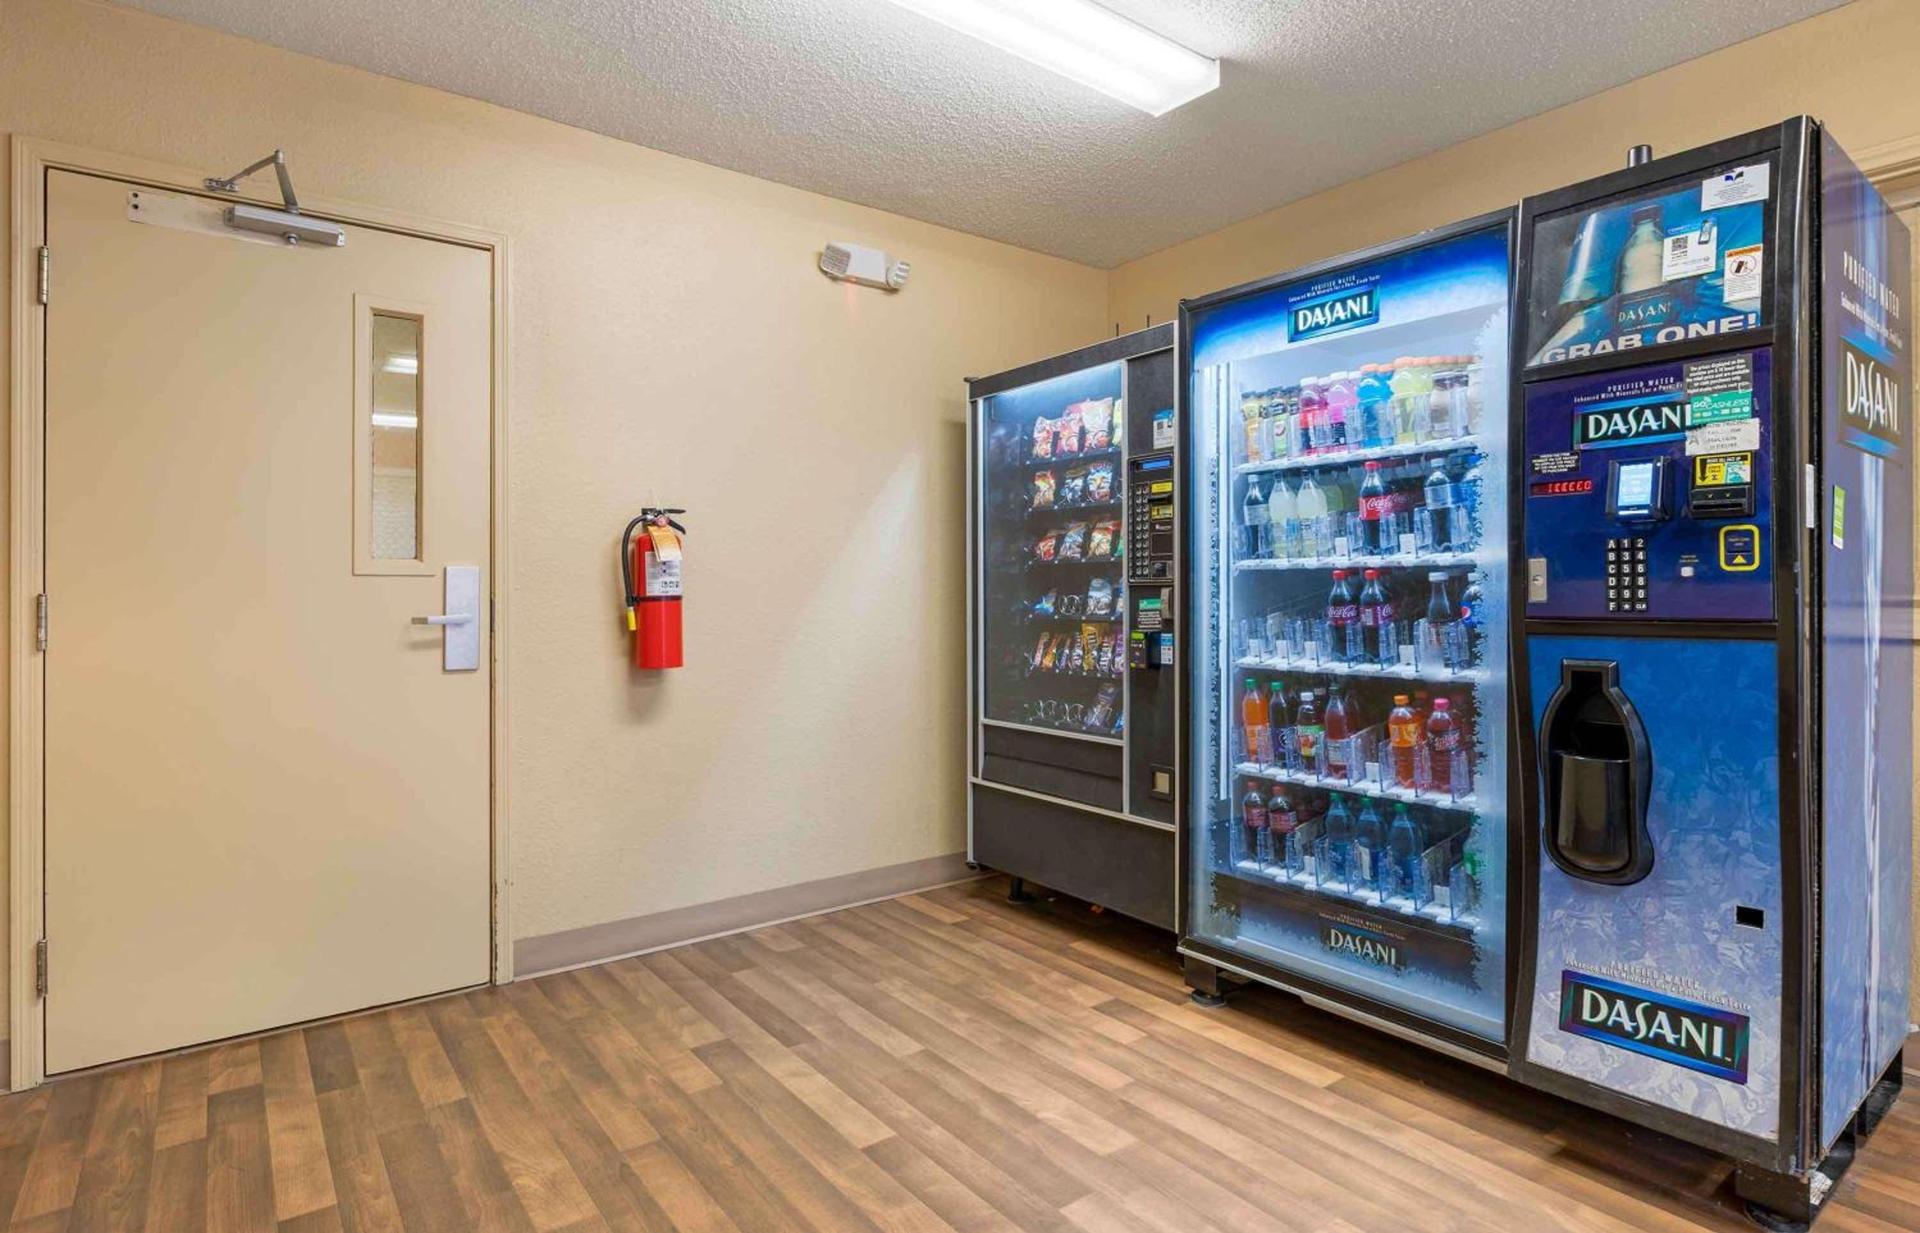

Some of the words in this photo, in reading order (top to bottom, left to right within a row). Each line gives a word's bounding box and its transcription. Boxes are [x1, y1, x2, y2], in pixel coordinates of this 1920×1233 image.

[1298, 296, 1368, 331] DASANI
[1618, 302, 1672, 322] DASANI
[1542, 333, 1642, 364] GRAB
[1656, 312, 1758, 344] ONE!
[1607, 380, 1644, 392] PURIFIED
[1648, 376, 1674, 386] WATER
[1846, 351, 1898, 434] DASANI
[1588, 403, 1691, 439] DASANI
[1608, 540, 1615, 548] A
[1623, 539, 1628, 548] 1
[1637, 539, 1644, 548] 2
[1623, 552, 1629, 560] 3
[1623, 565, 1630, 573] 5
[1623, 590, 1630, 598] 9
[1610, 602, 1615, 610] F
[1330, 928, 1396, 965] DASANI
[1582, 988, 1723, 1058] DASANI
